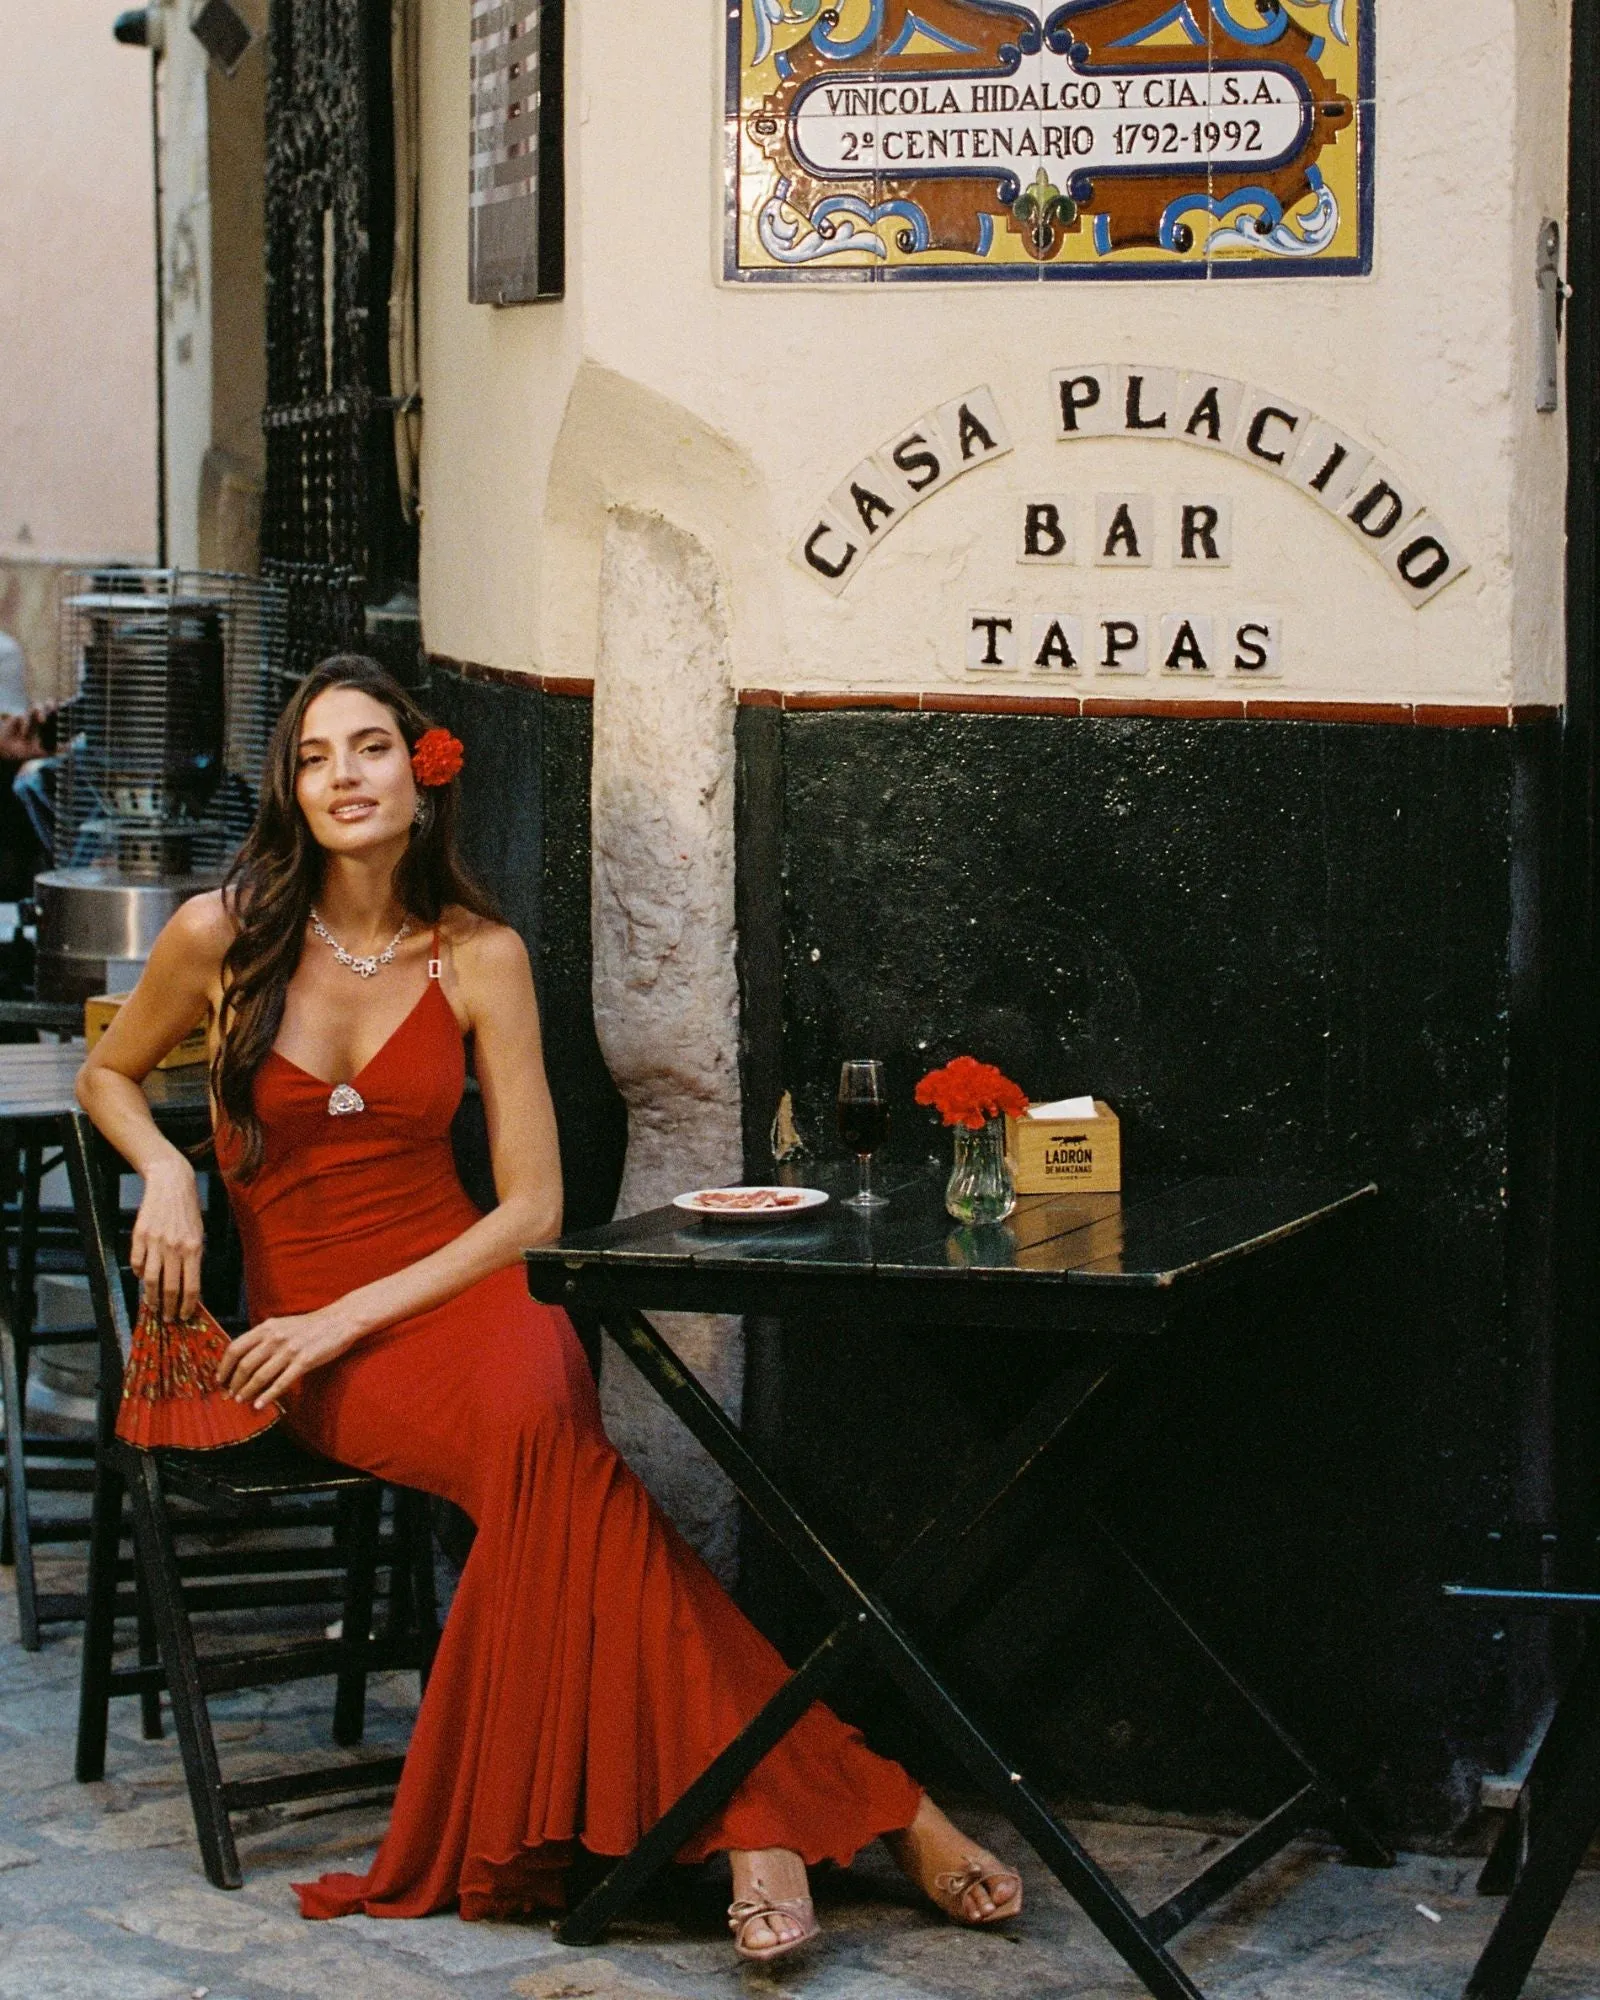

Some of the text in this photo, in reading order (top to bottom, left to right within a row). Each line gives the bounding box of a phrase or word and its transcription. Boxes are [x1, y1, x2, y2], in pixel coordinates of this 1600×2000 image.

[825, 76, 1281, 116] VINICOLA HIDALGO Y CIA. S.A.
[881, 125, 1094, 160] CENTENARIO
[1112, 119, 1263, 155] 1792-1992
[804, 374, 1450, 589] CASA PLACIDO
[1023, 502, 1219, 560] BAR
[971, 616, 1269, 672] TAPAS
